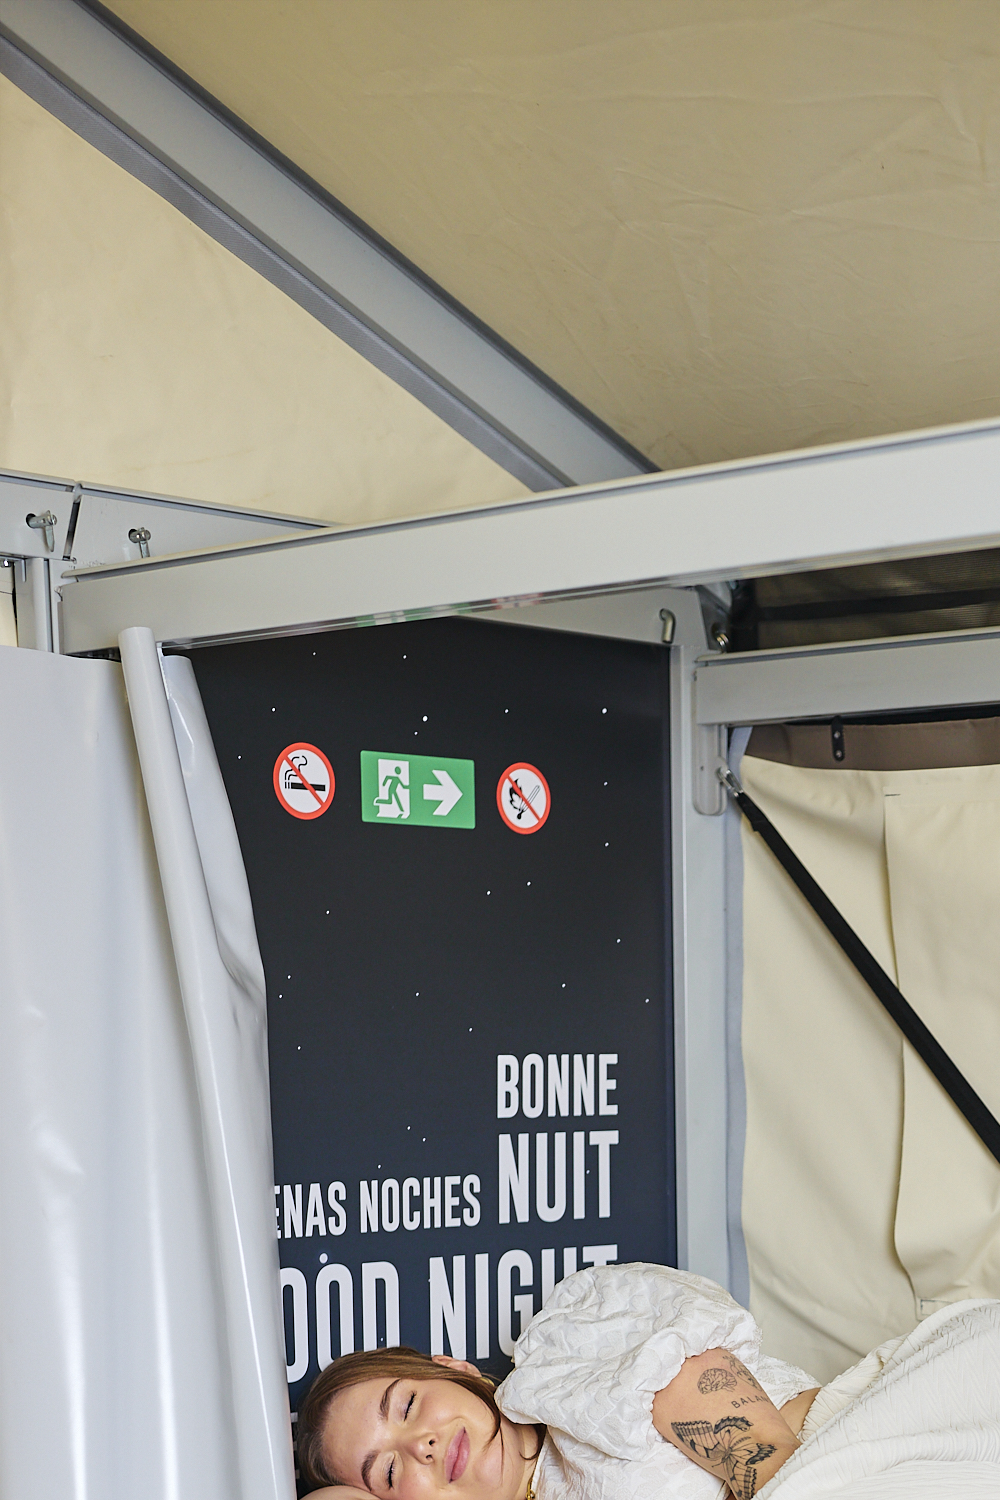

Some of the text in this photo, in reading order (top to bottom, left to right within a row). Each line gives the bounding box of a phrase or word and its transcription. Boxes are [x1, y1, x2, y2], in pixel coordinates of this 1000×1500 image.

[497, 1053, 619, 1119] BONNE
[359, 1173, 482, 1234] NOCHES
[498, 1129, 620, 1225] NUIT
